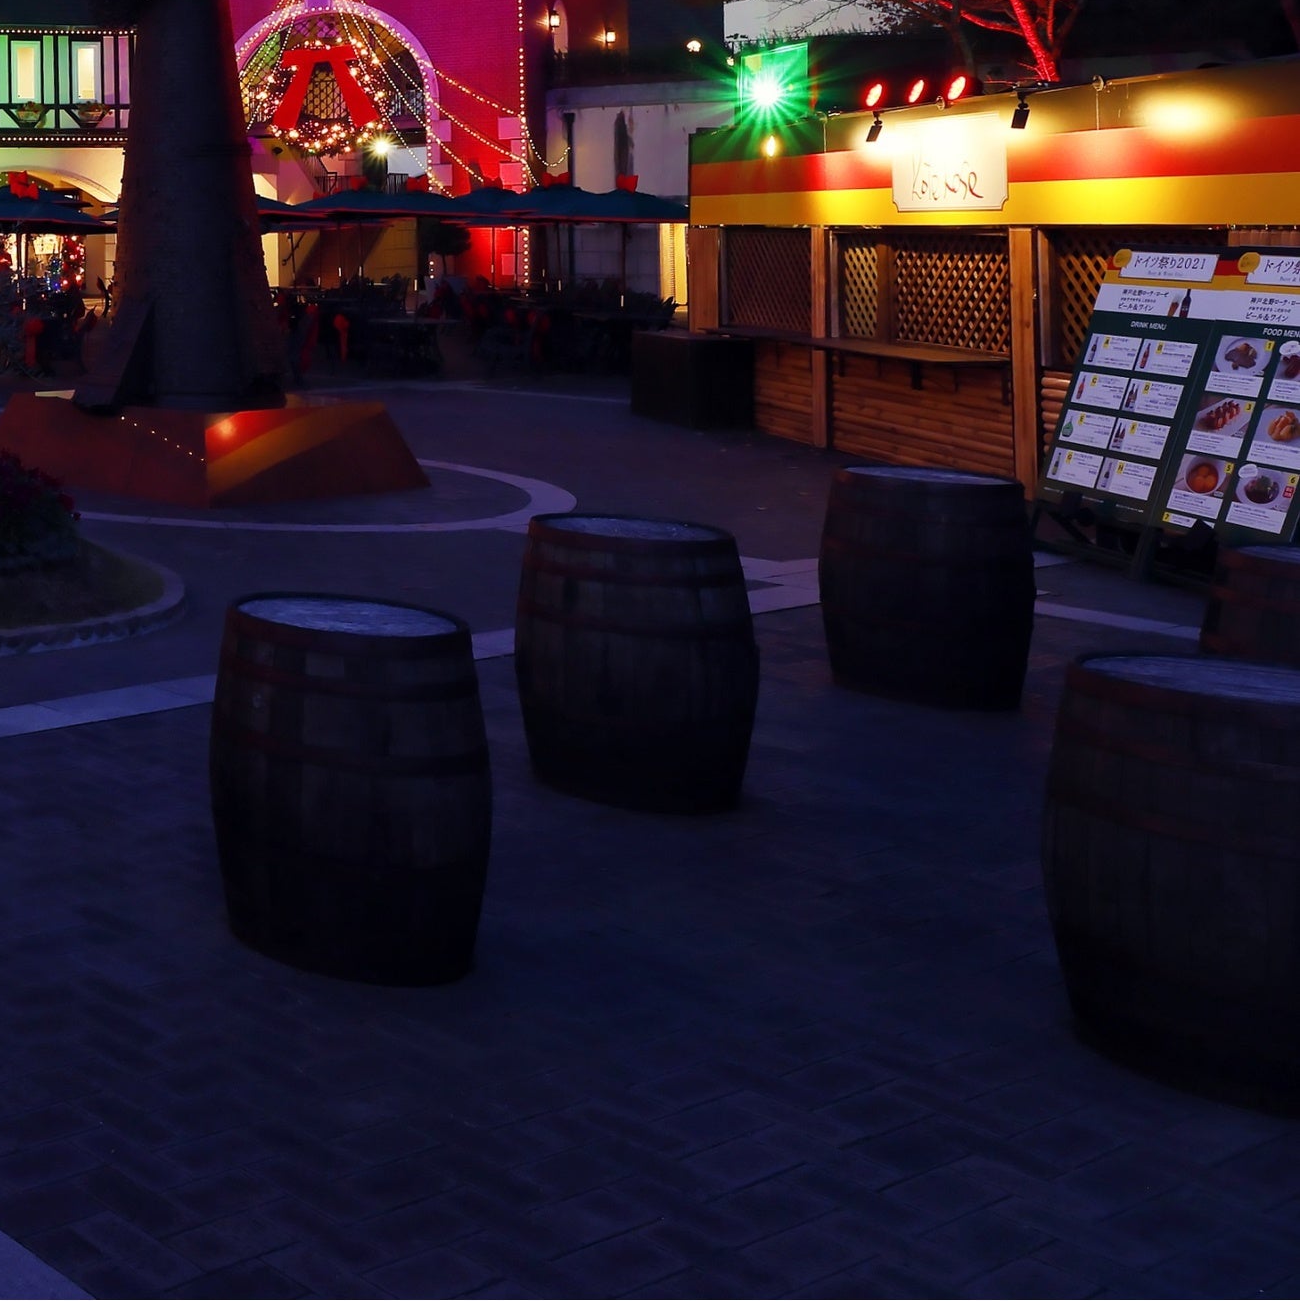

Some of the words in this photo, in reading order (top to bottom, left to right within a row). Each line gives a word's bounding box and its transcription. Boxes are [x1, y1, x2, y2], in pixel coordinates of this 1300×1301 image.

[1134, 255, 1206, 271] ドイツ祭り2021
[1264, 258, 1300, 275] ドイツ祭
[1130, 320, 1149, 329] DRINK
[1149, 322, 1168, 331] MENU
[1262, 327, 1283, 337] FOOD
[1283, 329, 1300, 338] MEN
